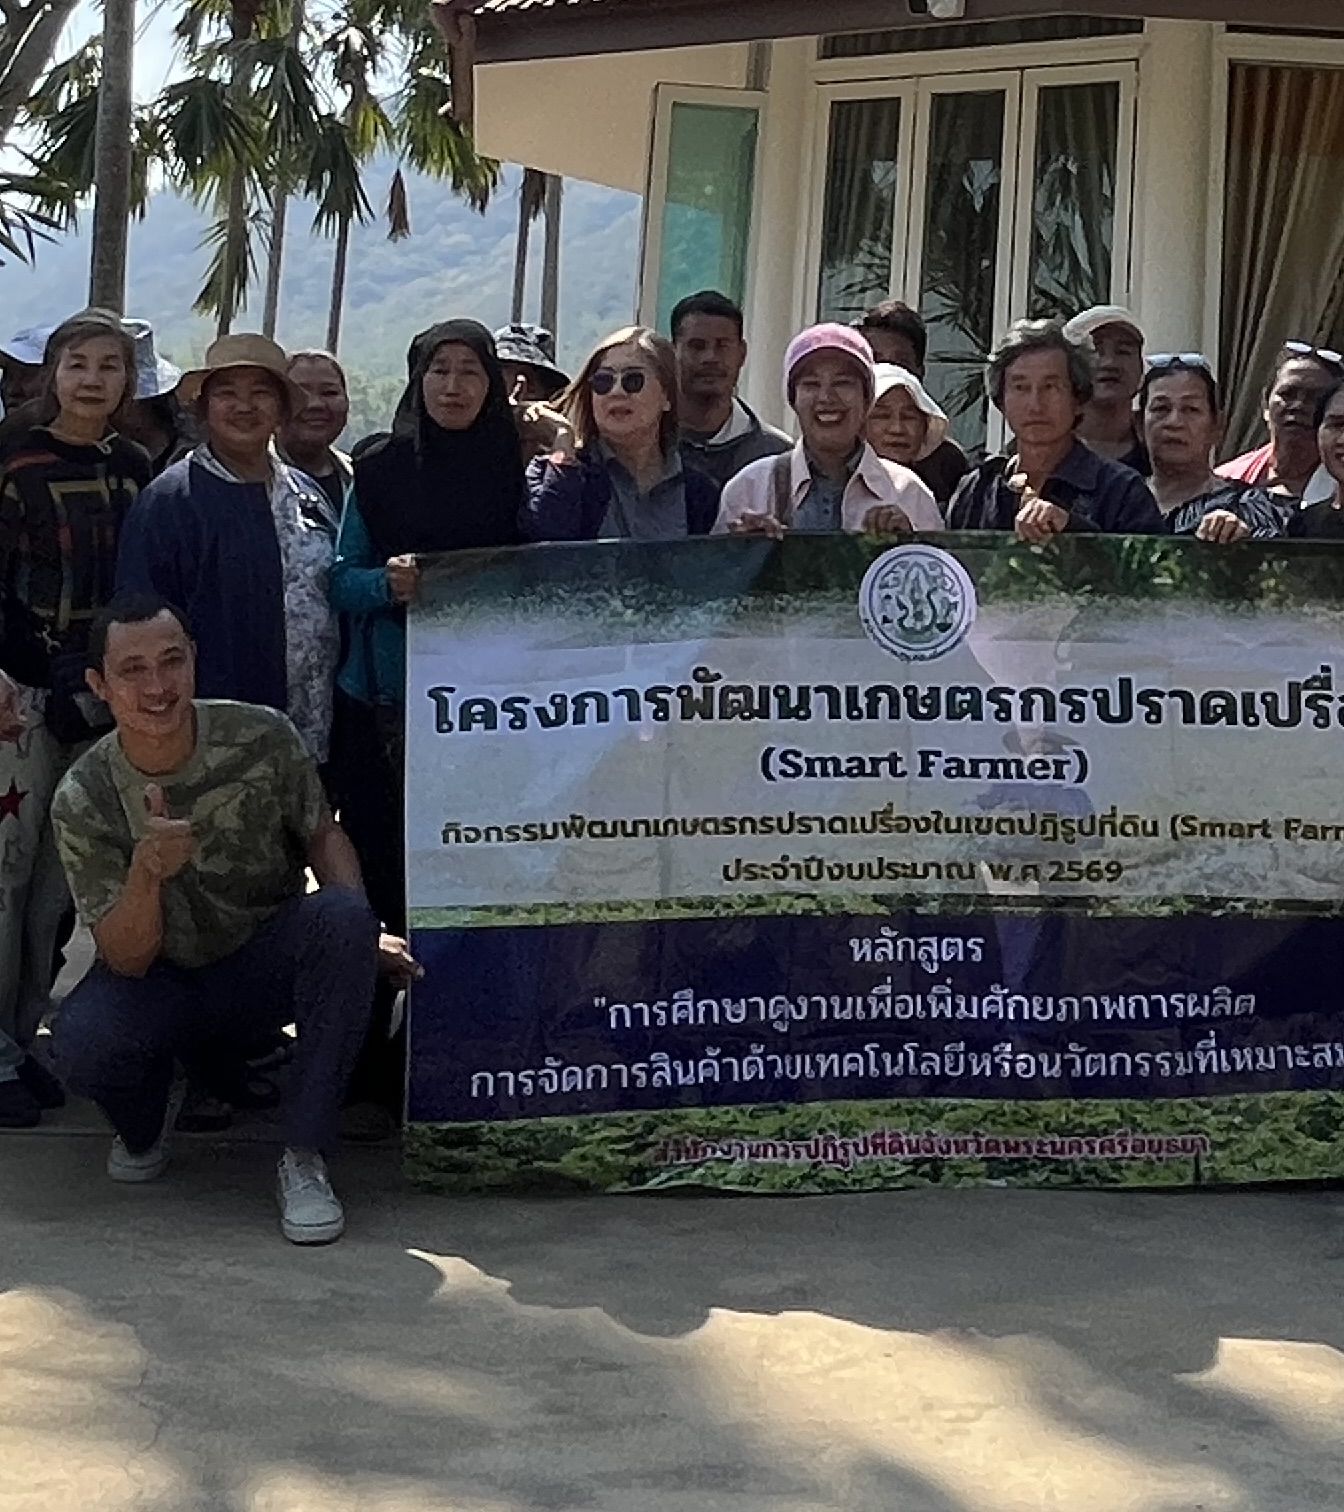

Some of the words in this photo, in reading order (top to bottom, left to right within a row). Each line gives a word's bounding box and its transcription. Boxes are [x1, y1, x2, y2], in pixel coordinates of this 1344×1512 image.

[760, 745, 908, 782] (Smart
[918, 749, 1089, 784] Farmer)
[441, 801, 1159, 845] กิจกรรมพัฒนาเกษตรกรปราดเปรื่องในเขตปฏิรูปที่ดิน
[1170, 813, 1272, 842] (Smart
[722, 854, 977, 882] ประจำปีงบประมาณ
[848, 925, 986, 975] หลักสูตร
[593, 976, 1257, 1033] "การศึกษาดูงานเพื่อเพิ่มศักยภาพการผลิต
